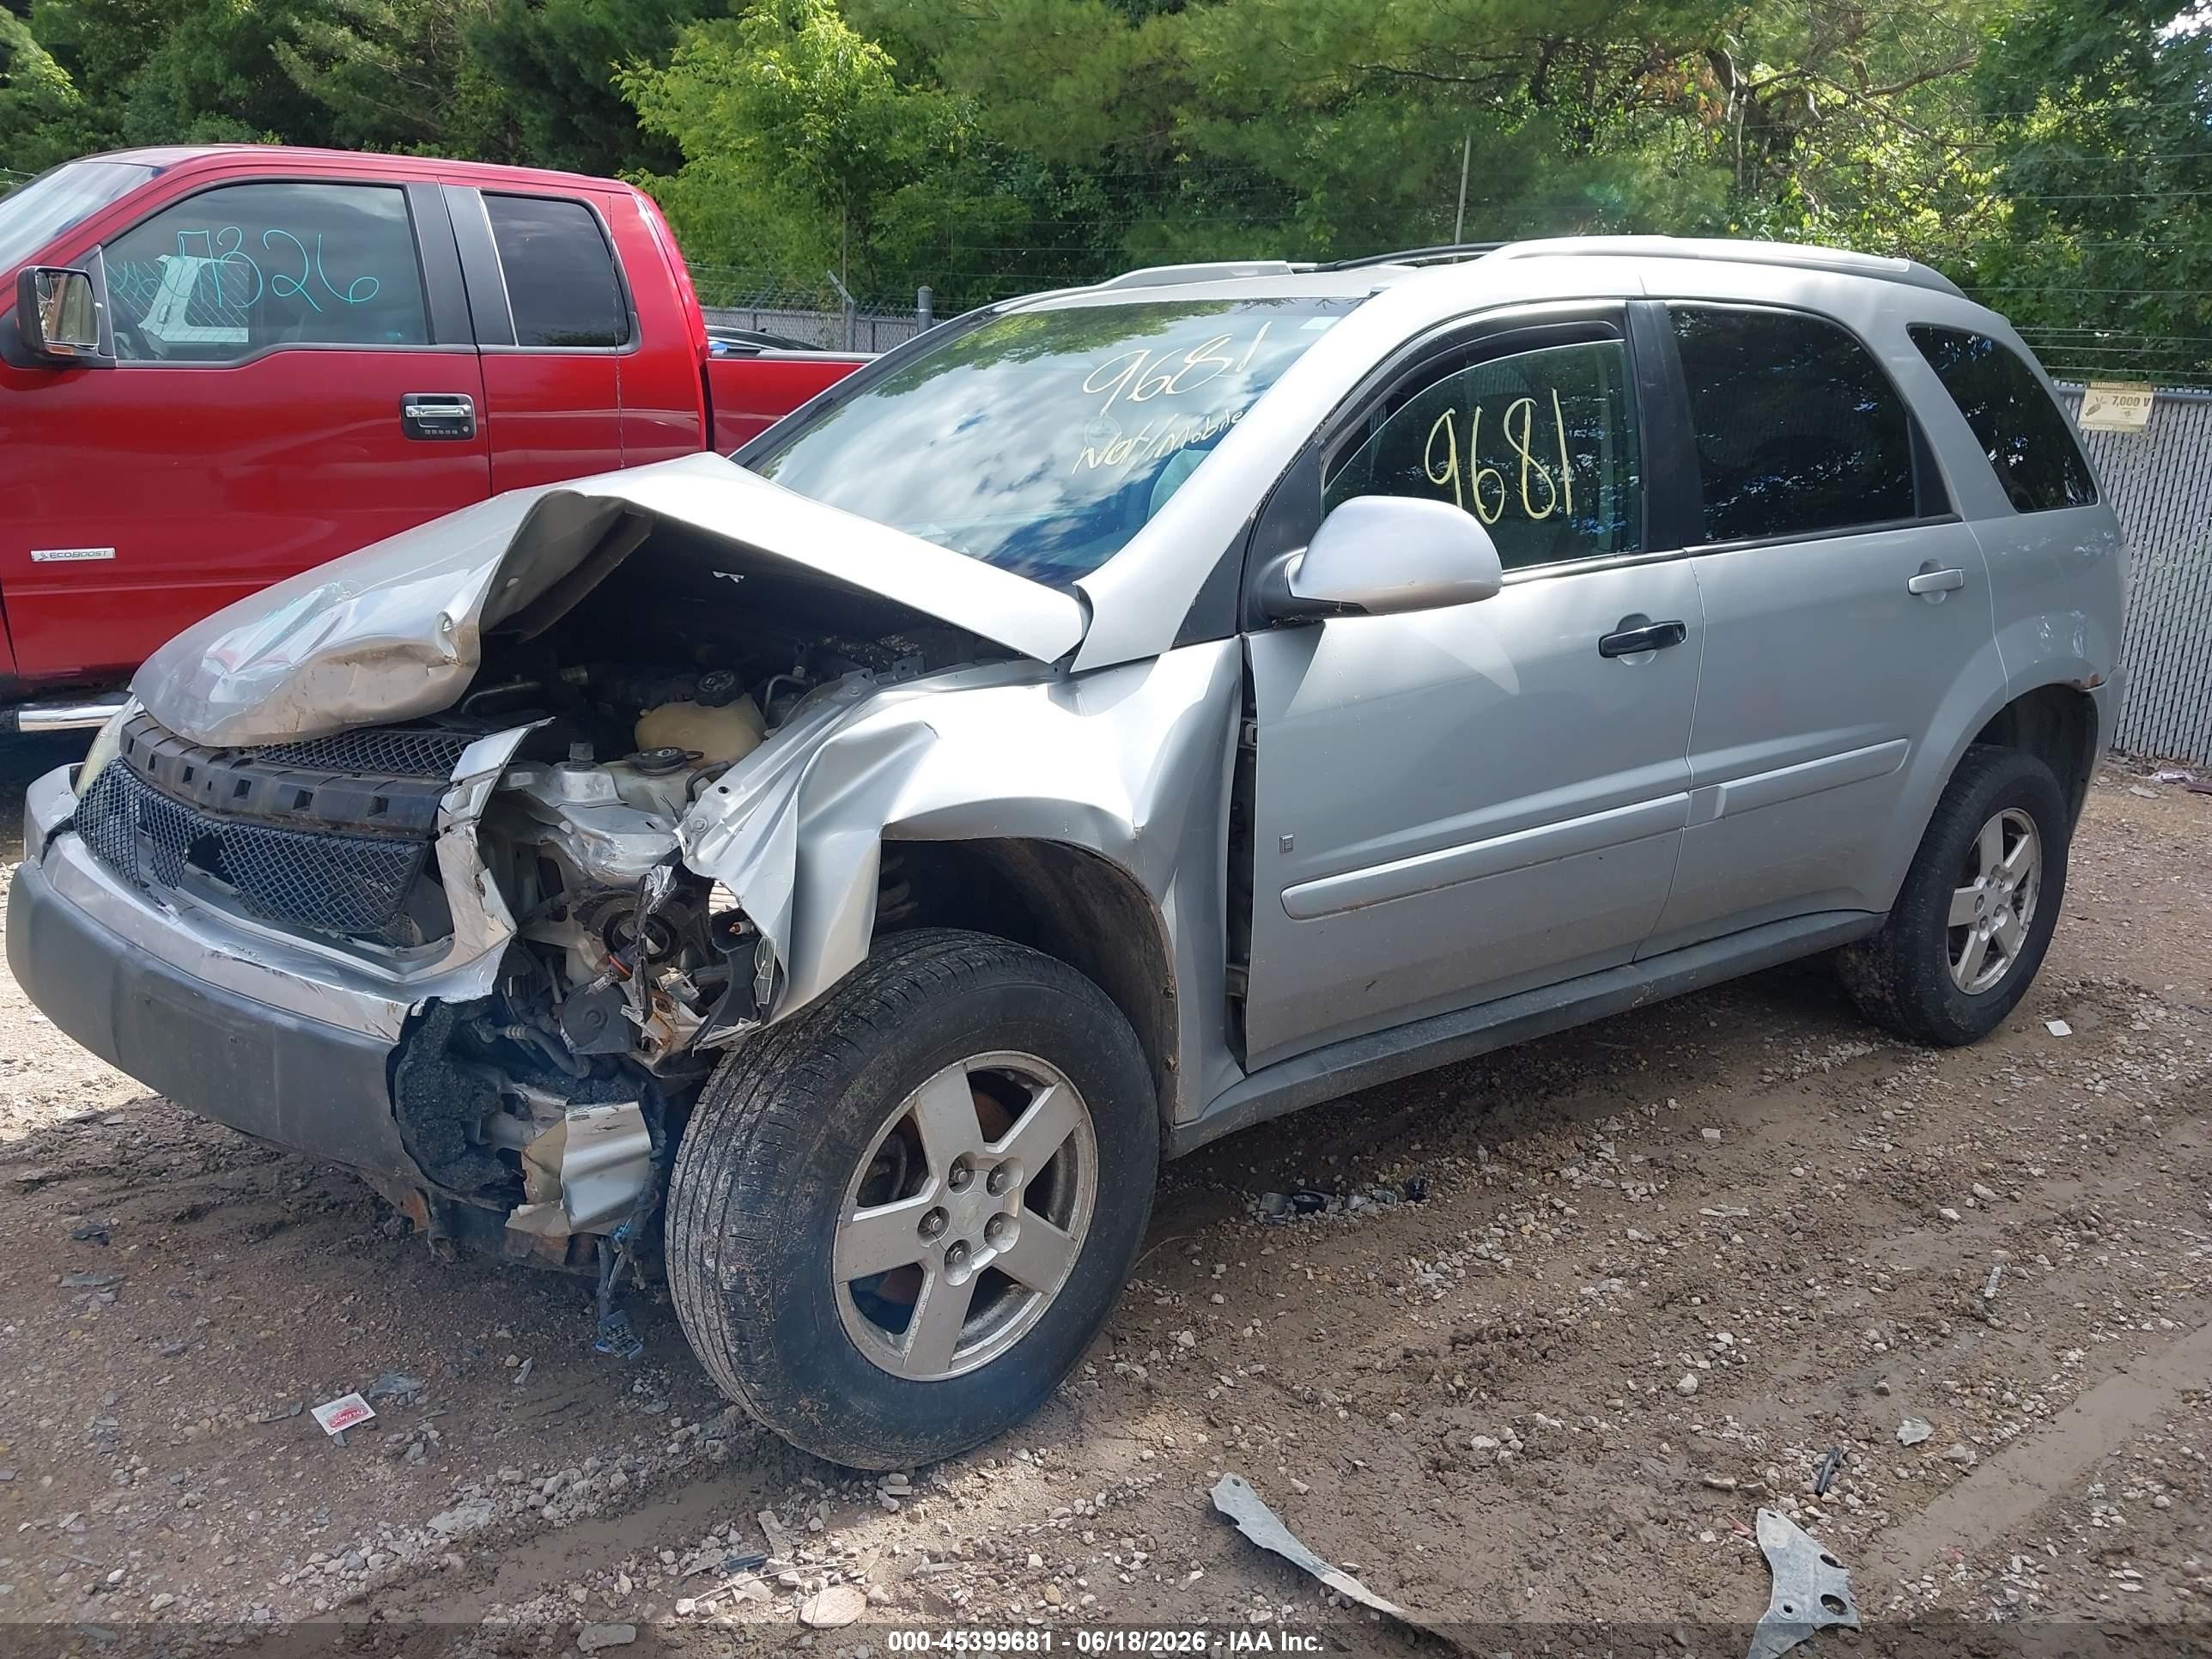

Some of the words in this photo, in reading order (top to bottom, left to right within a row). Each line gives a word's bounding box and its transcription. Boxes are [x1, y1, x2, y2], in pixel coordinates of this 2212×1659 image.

[1082, 321, 1273, 414] 9681
[2112, 395, 2140, 407] 7,000
[2142, 397, 2150, 407] V
[1424, 386, 1573, 526] 9681
